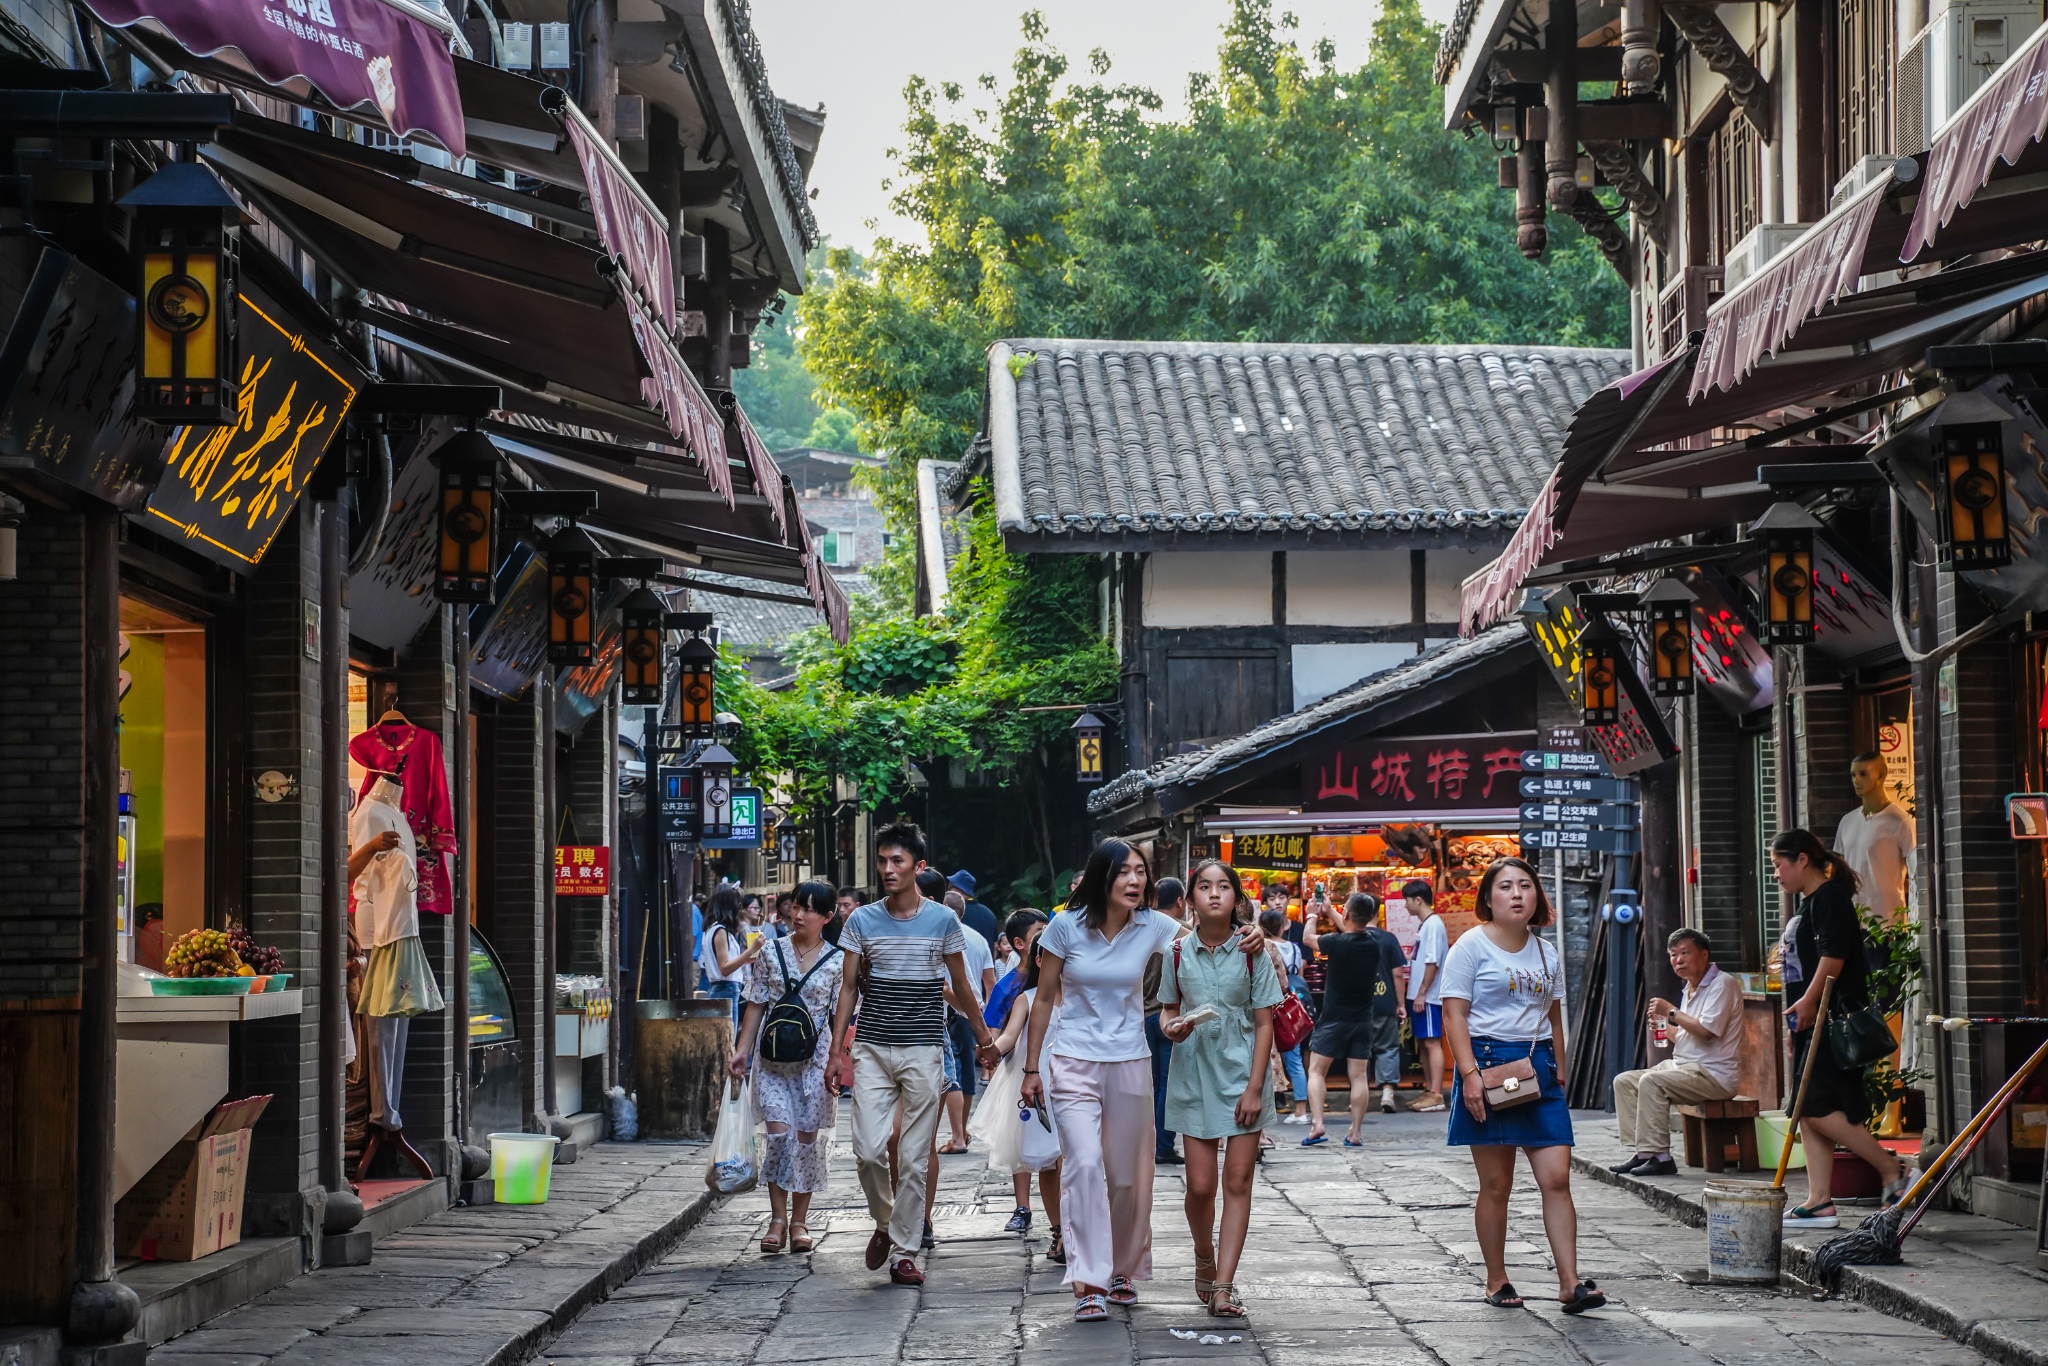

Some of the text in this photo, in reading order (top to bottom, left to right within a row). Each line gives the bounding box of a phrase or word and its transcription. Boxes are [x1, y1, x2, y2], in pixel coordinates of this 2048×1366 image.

[263, 5, 365, 60] 全国热销的小瓶白酒
[1561, 754, 1595, 764] 紧急出口
[1317, 748, 1523, 801] 山城特产
[661, 802, 698, 810] 公共卫生间
[1561, 806, 1598, 816] 公交车站
[1560, 833, 1587, 842] 卫生间
[1238, 834, 1304, 860] 全场包邮
